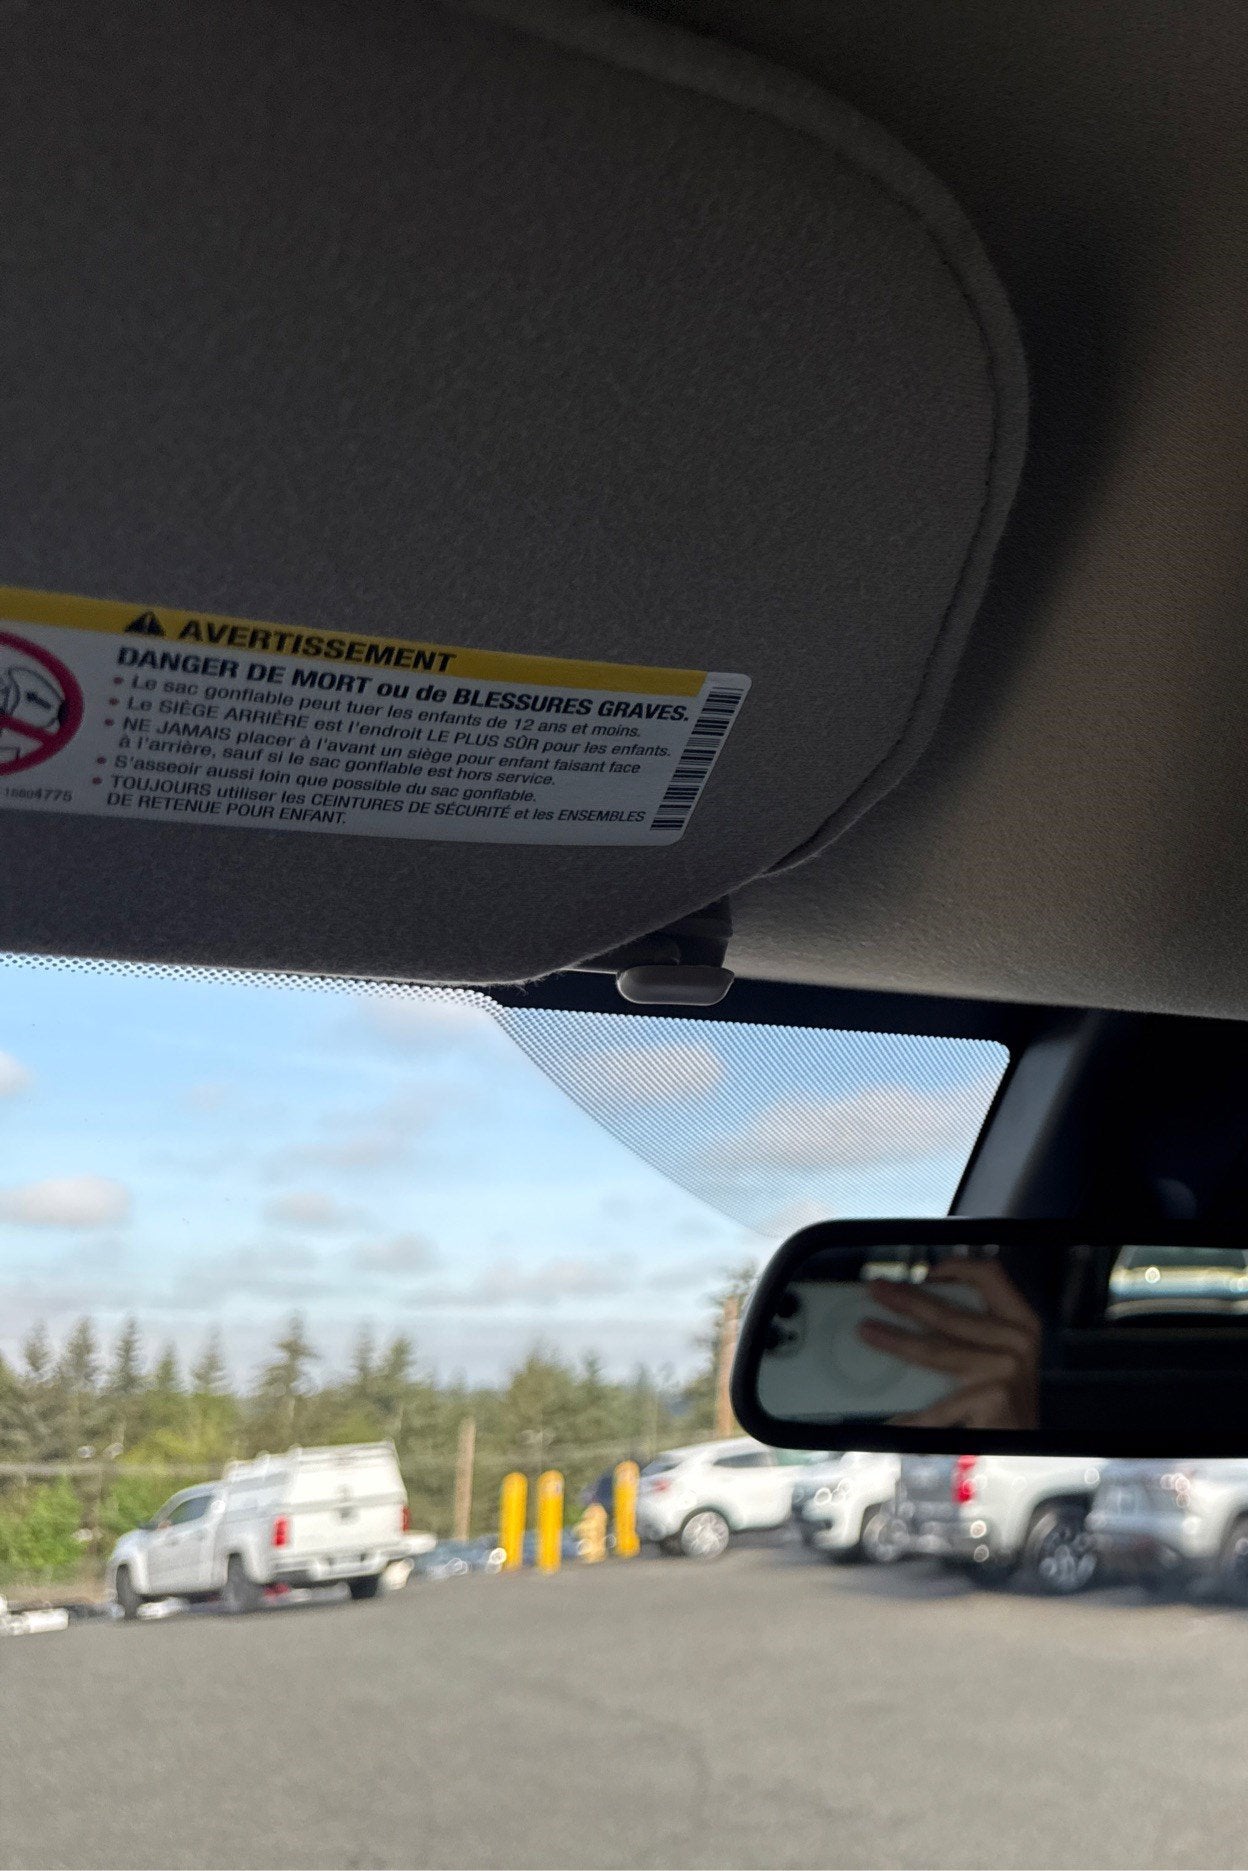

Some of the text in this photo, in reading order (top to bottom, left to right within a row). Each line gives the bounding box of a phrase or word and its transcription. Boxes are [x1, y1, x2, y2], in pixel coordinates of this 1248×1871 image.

[178, 619, 457, 673] AVERTISSEMENT
[117, 647, 689, 721] DANGER DE MORT ou de BLESSURES GRAVES.
[131, 675, 641, 738] Le sac gonflable peut tuer les enfants de 12 ans et moins.
[123, 717, 641, 774] NE JAMAIS placer à l'avant un siège pour enfant faisant face
[127, 696, 671, 757] Le SIÈGE ARRIÈRE est l'endroit LE PLUS SÛR pour les enfants.
[114, 755, 536, 802] S'asseoir aussi loin que possible du sac gonflable.
[118, 735, 555, 786] à l'arrière, sauf si le sac gonflable est hors service.
[106, 792, 346, 825] DE RETENUE POUR ENFANT.
[111, 775, 646, 823] TOUJOURS utiliser les CEINTURES DE SÉCURITÉ et les ENSEMBLES
